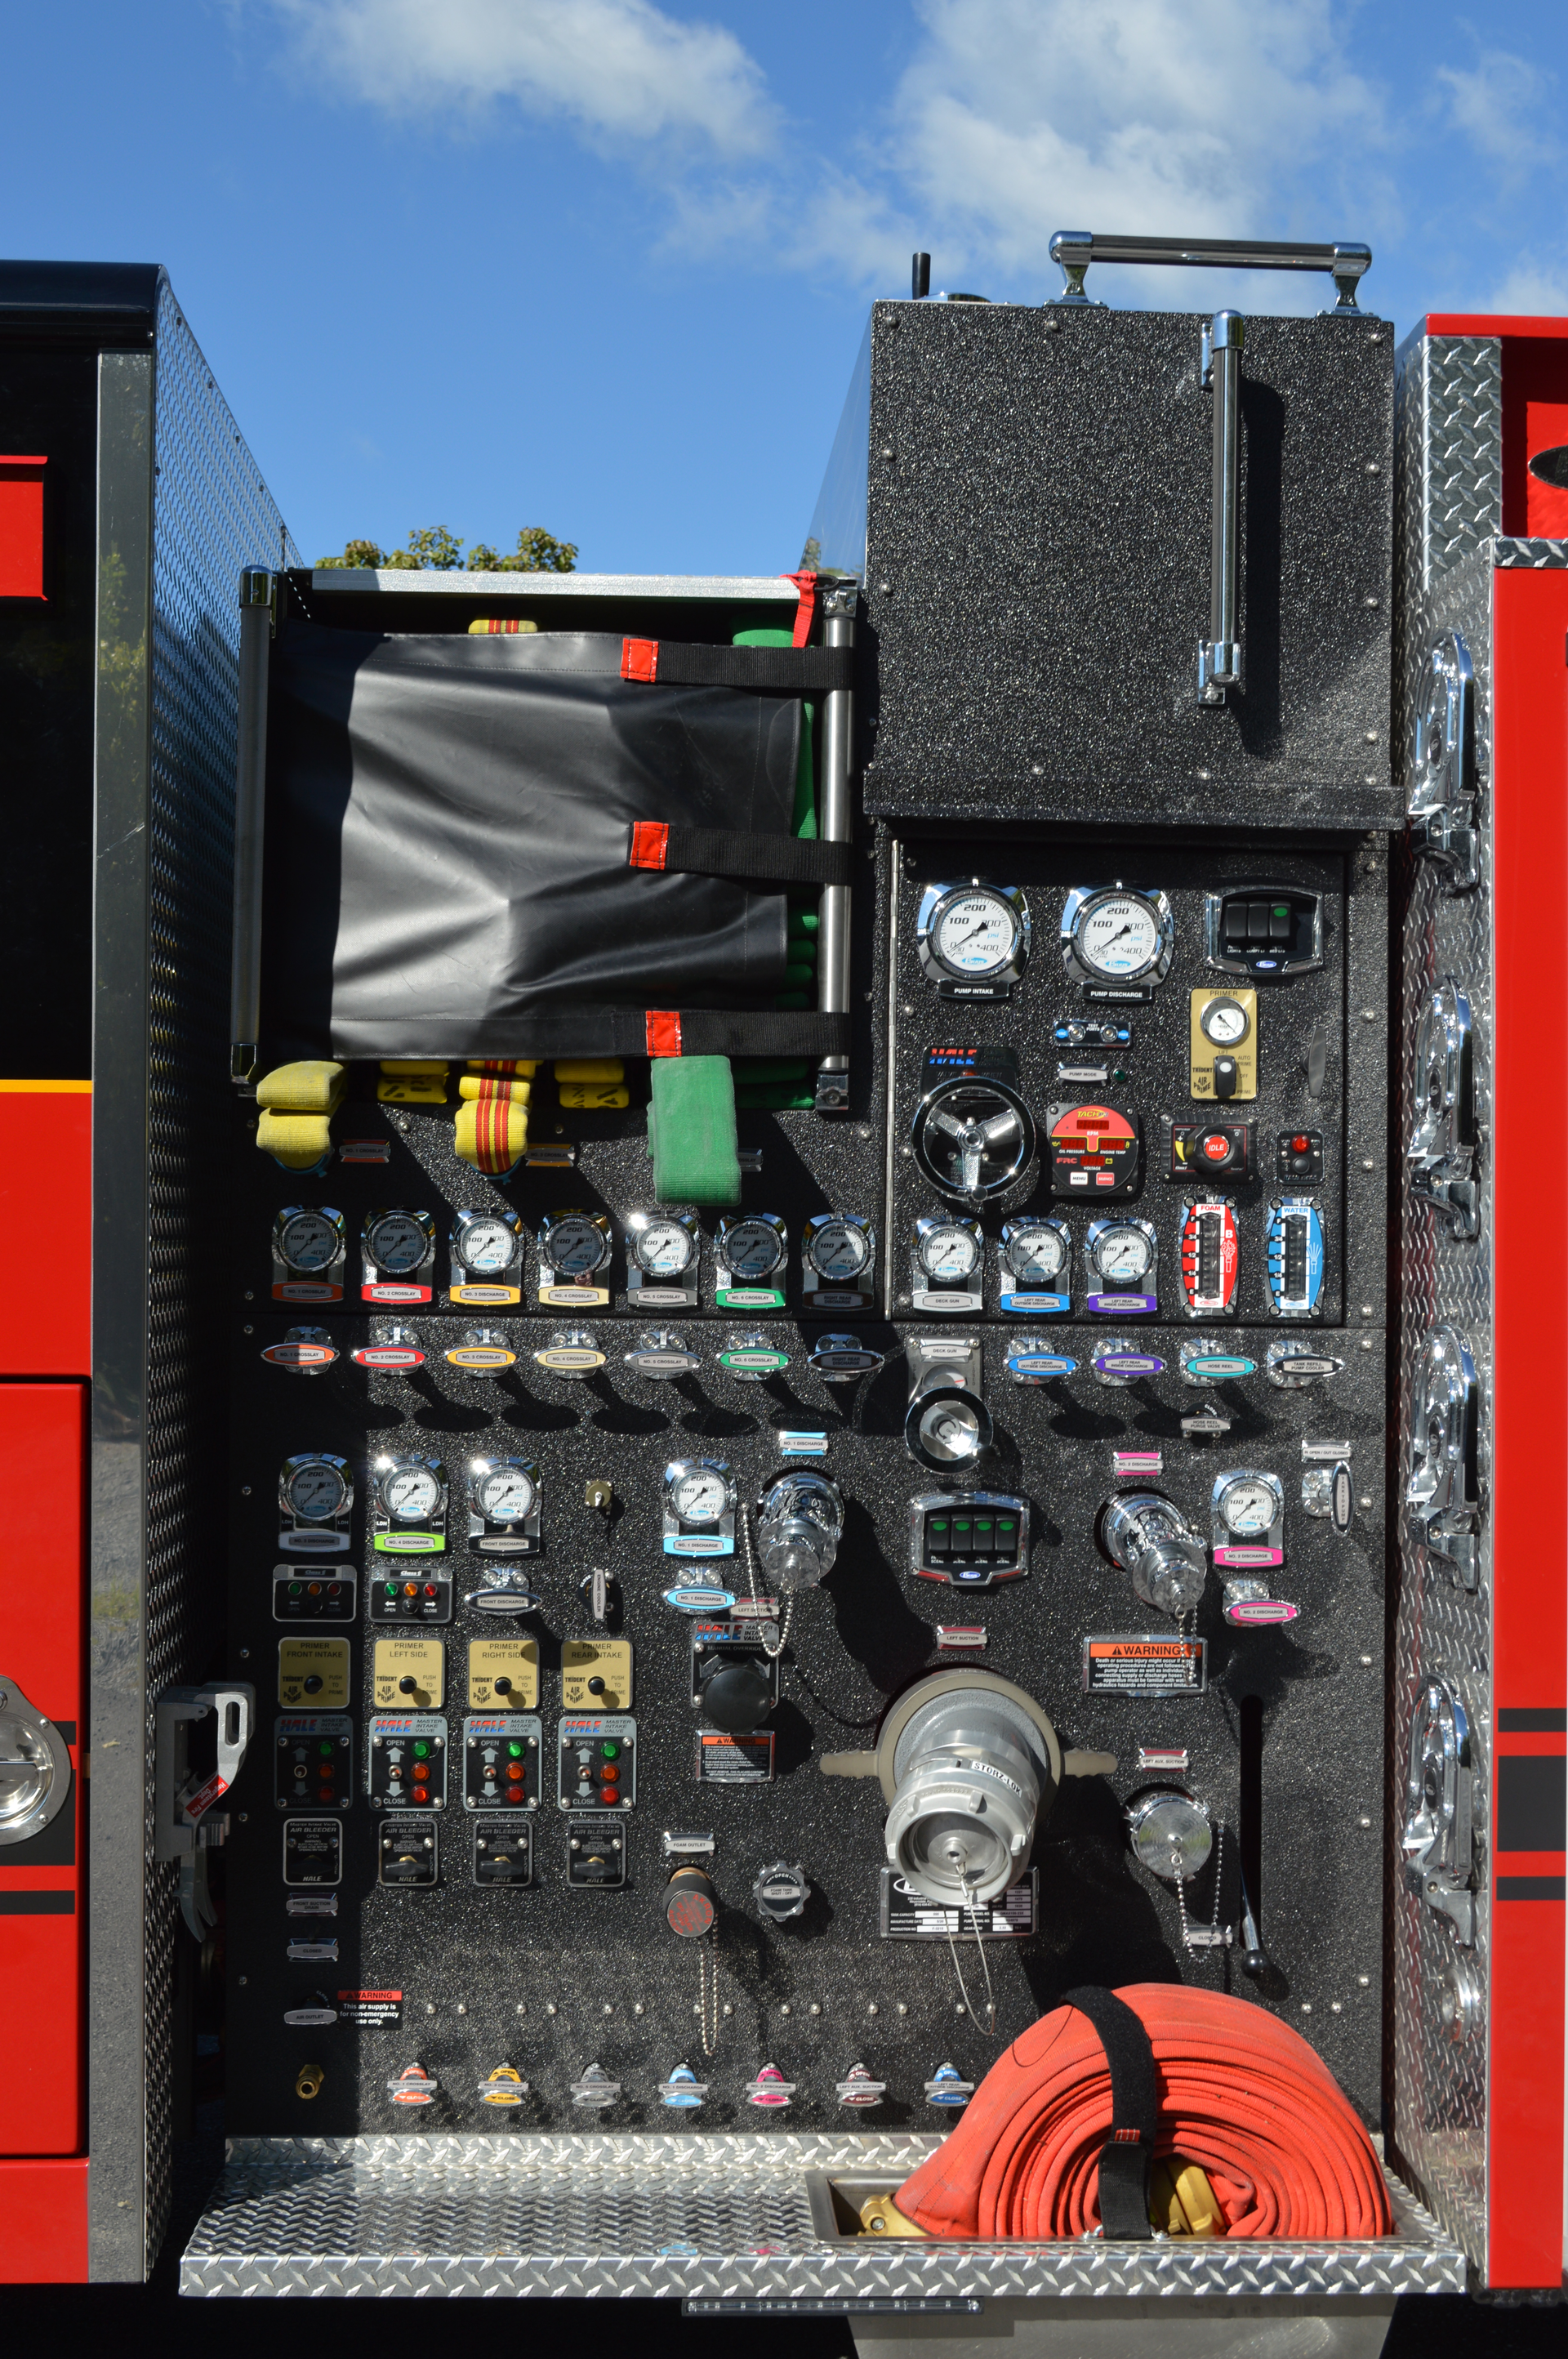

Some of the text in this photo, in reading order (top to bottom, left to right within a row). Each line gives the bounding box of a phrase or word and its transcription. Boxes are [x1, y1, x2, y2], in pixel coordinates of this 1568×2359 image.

[987, 931, 1000, 939] psi
[980, 944, 1000, 952] 400
[1123, 947, 1143, 955] 400
[1225, 1230, 1233, 1238] B
[1124, 1646, 1181, 1655] WARNING
[280, 1719, 317, 1732] HALE
[375, 1720, 412, 1732] HALE
[470, 1720, 506, 1732] HALE
[564, 1721, 601, 1732] HALE
[974, 1763, 1022, 1795] STORZ-LOK
[191, 1782, 226, 1814] Hagerstown Fire
[198, 1788, 211, 1799] Dept.
[693, 1894, 712, 1924] AKRON
[350, 2011, 399, 2019] non-emergency
